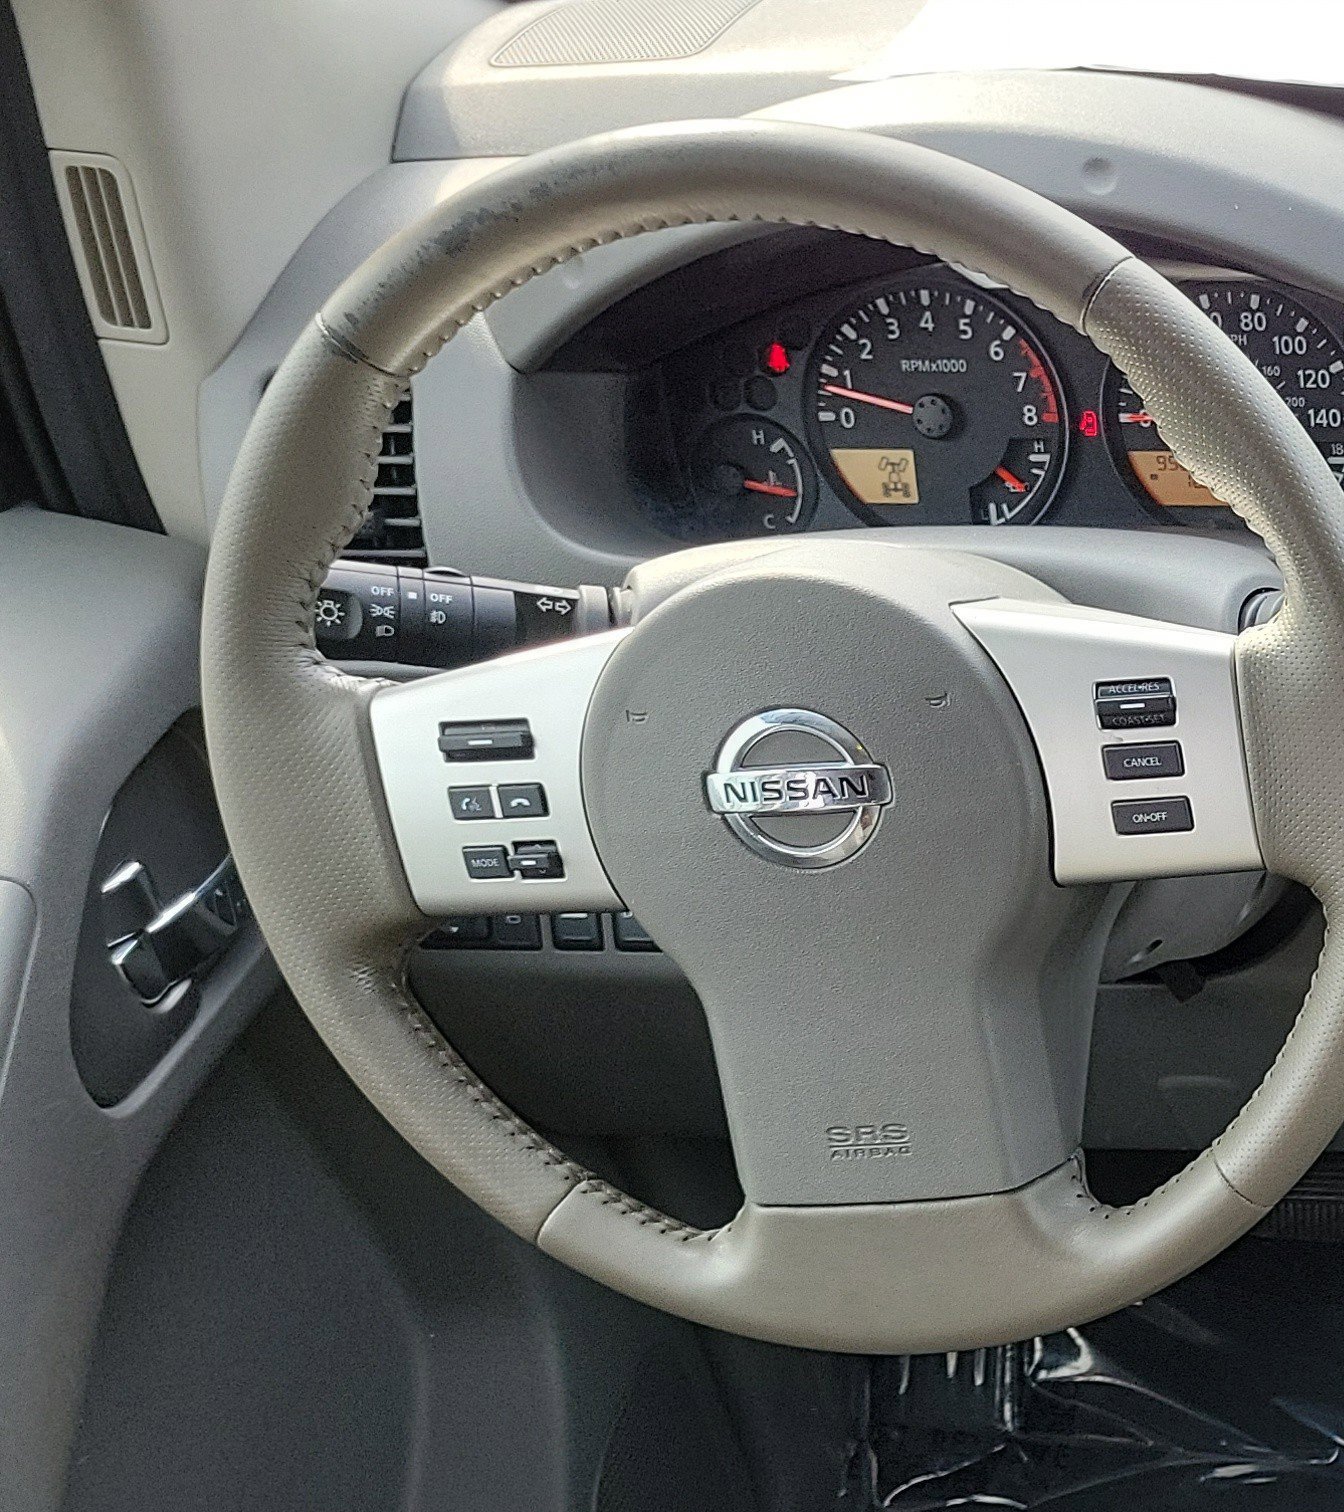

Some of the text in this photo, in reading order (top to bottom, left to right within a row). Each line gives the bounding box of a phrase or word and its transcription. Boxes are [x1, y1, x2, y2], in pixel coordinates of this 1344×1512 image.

[887, 318, 899, 339] 3
[920, 312, 933, 331] 4
[959, 319, 972, 339] 5
[1240, 312, 1266, 331] 80
[858, 340, 873, 360] 2
[989, 340, 1003, 360] 6
[1272, 336, 1307, 355] 100
[843, 370, 852, 388] 1
[1013, 372, 1026, 391] 7
[1297, 370, 1330, 389] 120
[840, 408, 855, 428] 0
[1022, 405, 1037, 425] 8
[1308, 409, 1341, 428] 140
[752, 430, 764, 444] H
[1034, 441, 1044, 453] H
[1330, 444, 1344, 456] 18
[763, 514, 776, 529] C
[371, 586, 395, 596] OFF
[429, 593, 453, 604] OFF
[1123, 757, 1162, 768] CANCEL
[723, 774, 868, 804] NISSAN
[470, 858, 499, 868] MODE
[826, 1123, 912, 1145] SRS
[829, 1145, 912, 1160] AIRBAG
